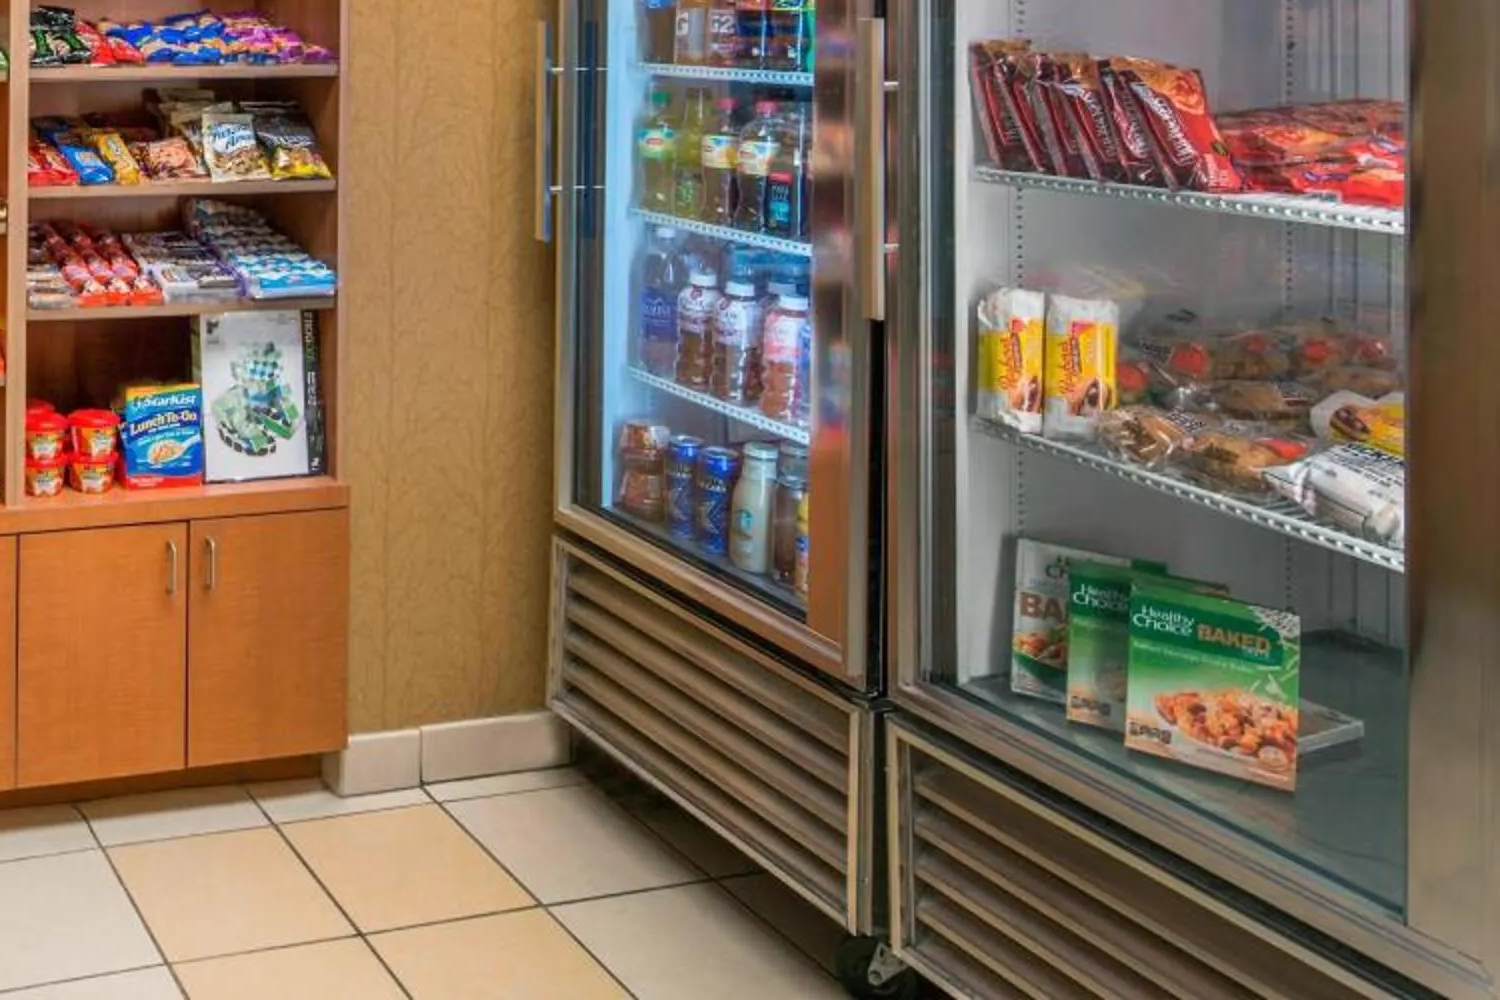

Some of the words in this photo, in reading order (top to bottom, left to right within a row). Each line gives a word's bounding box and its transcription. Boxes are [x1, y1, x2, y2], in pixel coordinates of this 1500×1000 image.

[143, 394, 197, 408] StarKist
[1132, 613, 1193, 637] Choice
[1141, 604, 1195, 626] Healthy
[1196, 623, 1271, 654] BAKED
